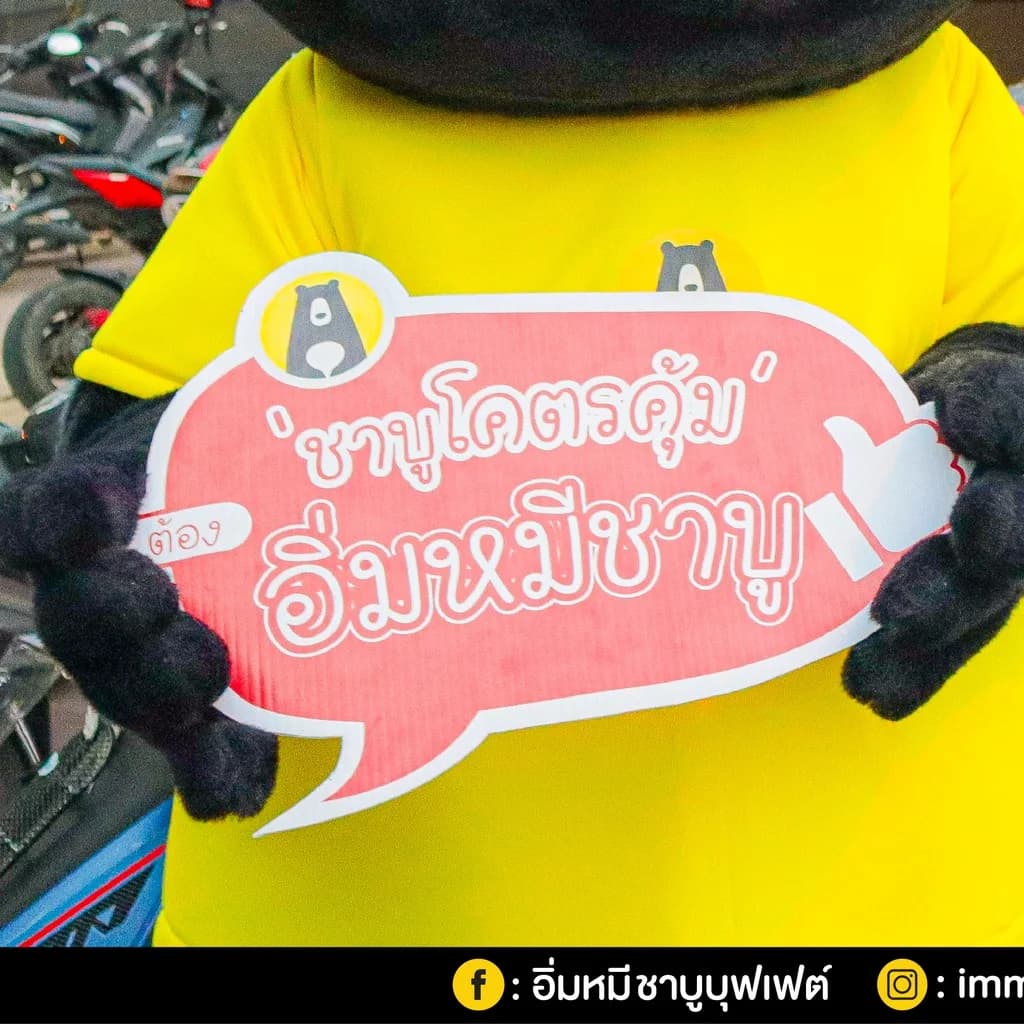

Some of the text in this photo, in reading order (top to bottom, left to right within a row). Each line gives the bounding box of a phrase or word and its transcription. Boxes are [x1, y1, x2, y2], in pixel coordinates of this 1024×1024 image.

[148, 517, 221, 556] ต้อง
[255, 476, 803, 657] อิ่มหมีชาบู
